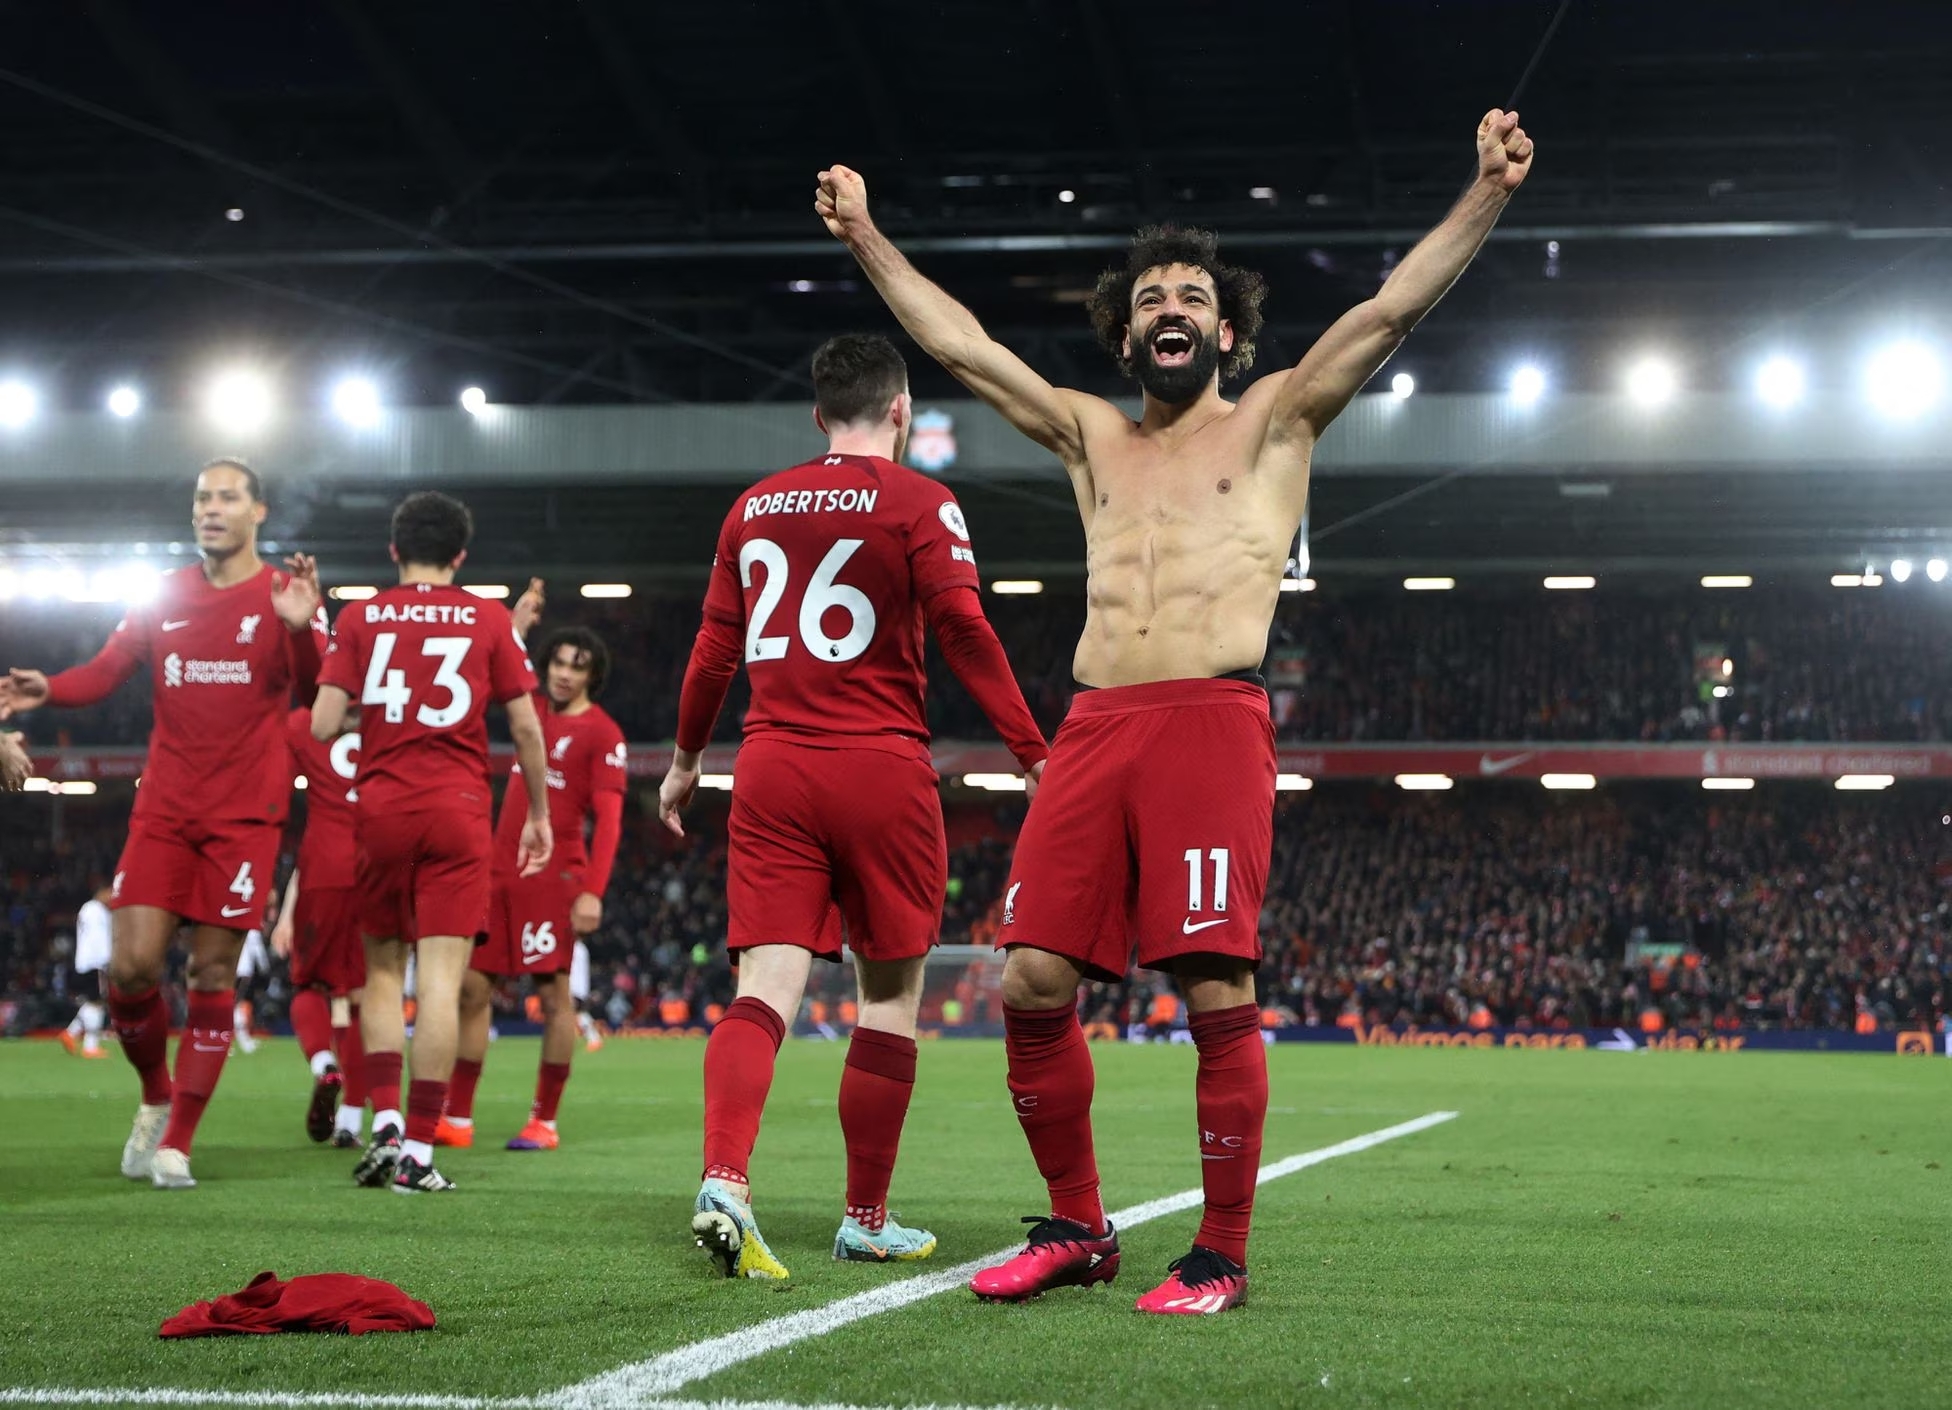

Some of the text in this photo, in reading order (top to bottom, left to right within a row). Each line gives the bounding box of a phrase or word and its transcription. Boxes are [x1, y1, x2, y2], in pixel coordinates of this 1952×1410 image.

[743, 489, 878, 522] ROBERTSON
[365, 604, 477, 625] BAJCETIC
[739, 537, 876, 664] 26
[184, 671, 252, 684] chartered
[185, 659, 249, 673] standard
[361, 632, 473, 728] 43
[229, 861, 255, 902] 4
[1184, 848, 1229, 912] 11
[521, 921, 557, 955] 66
